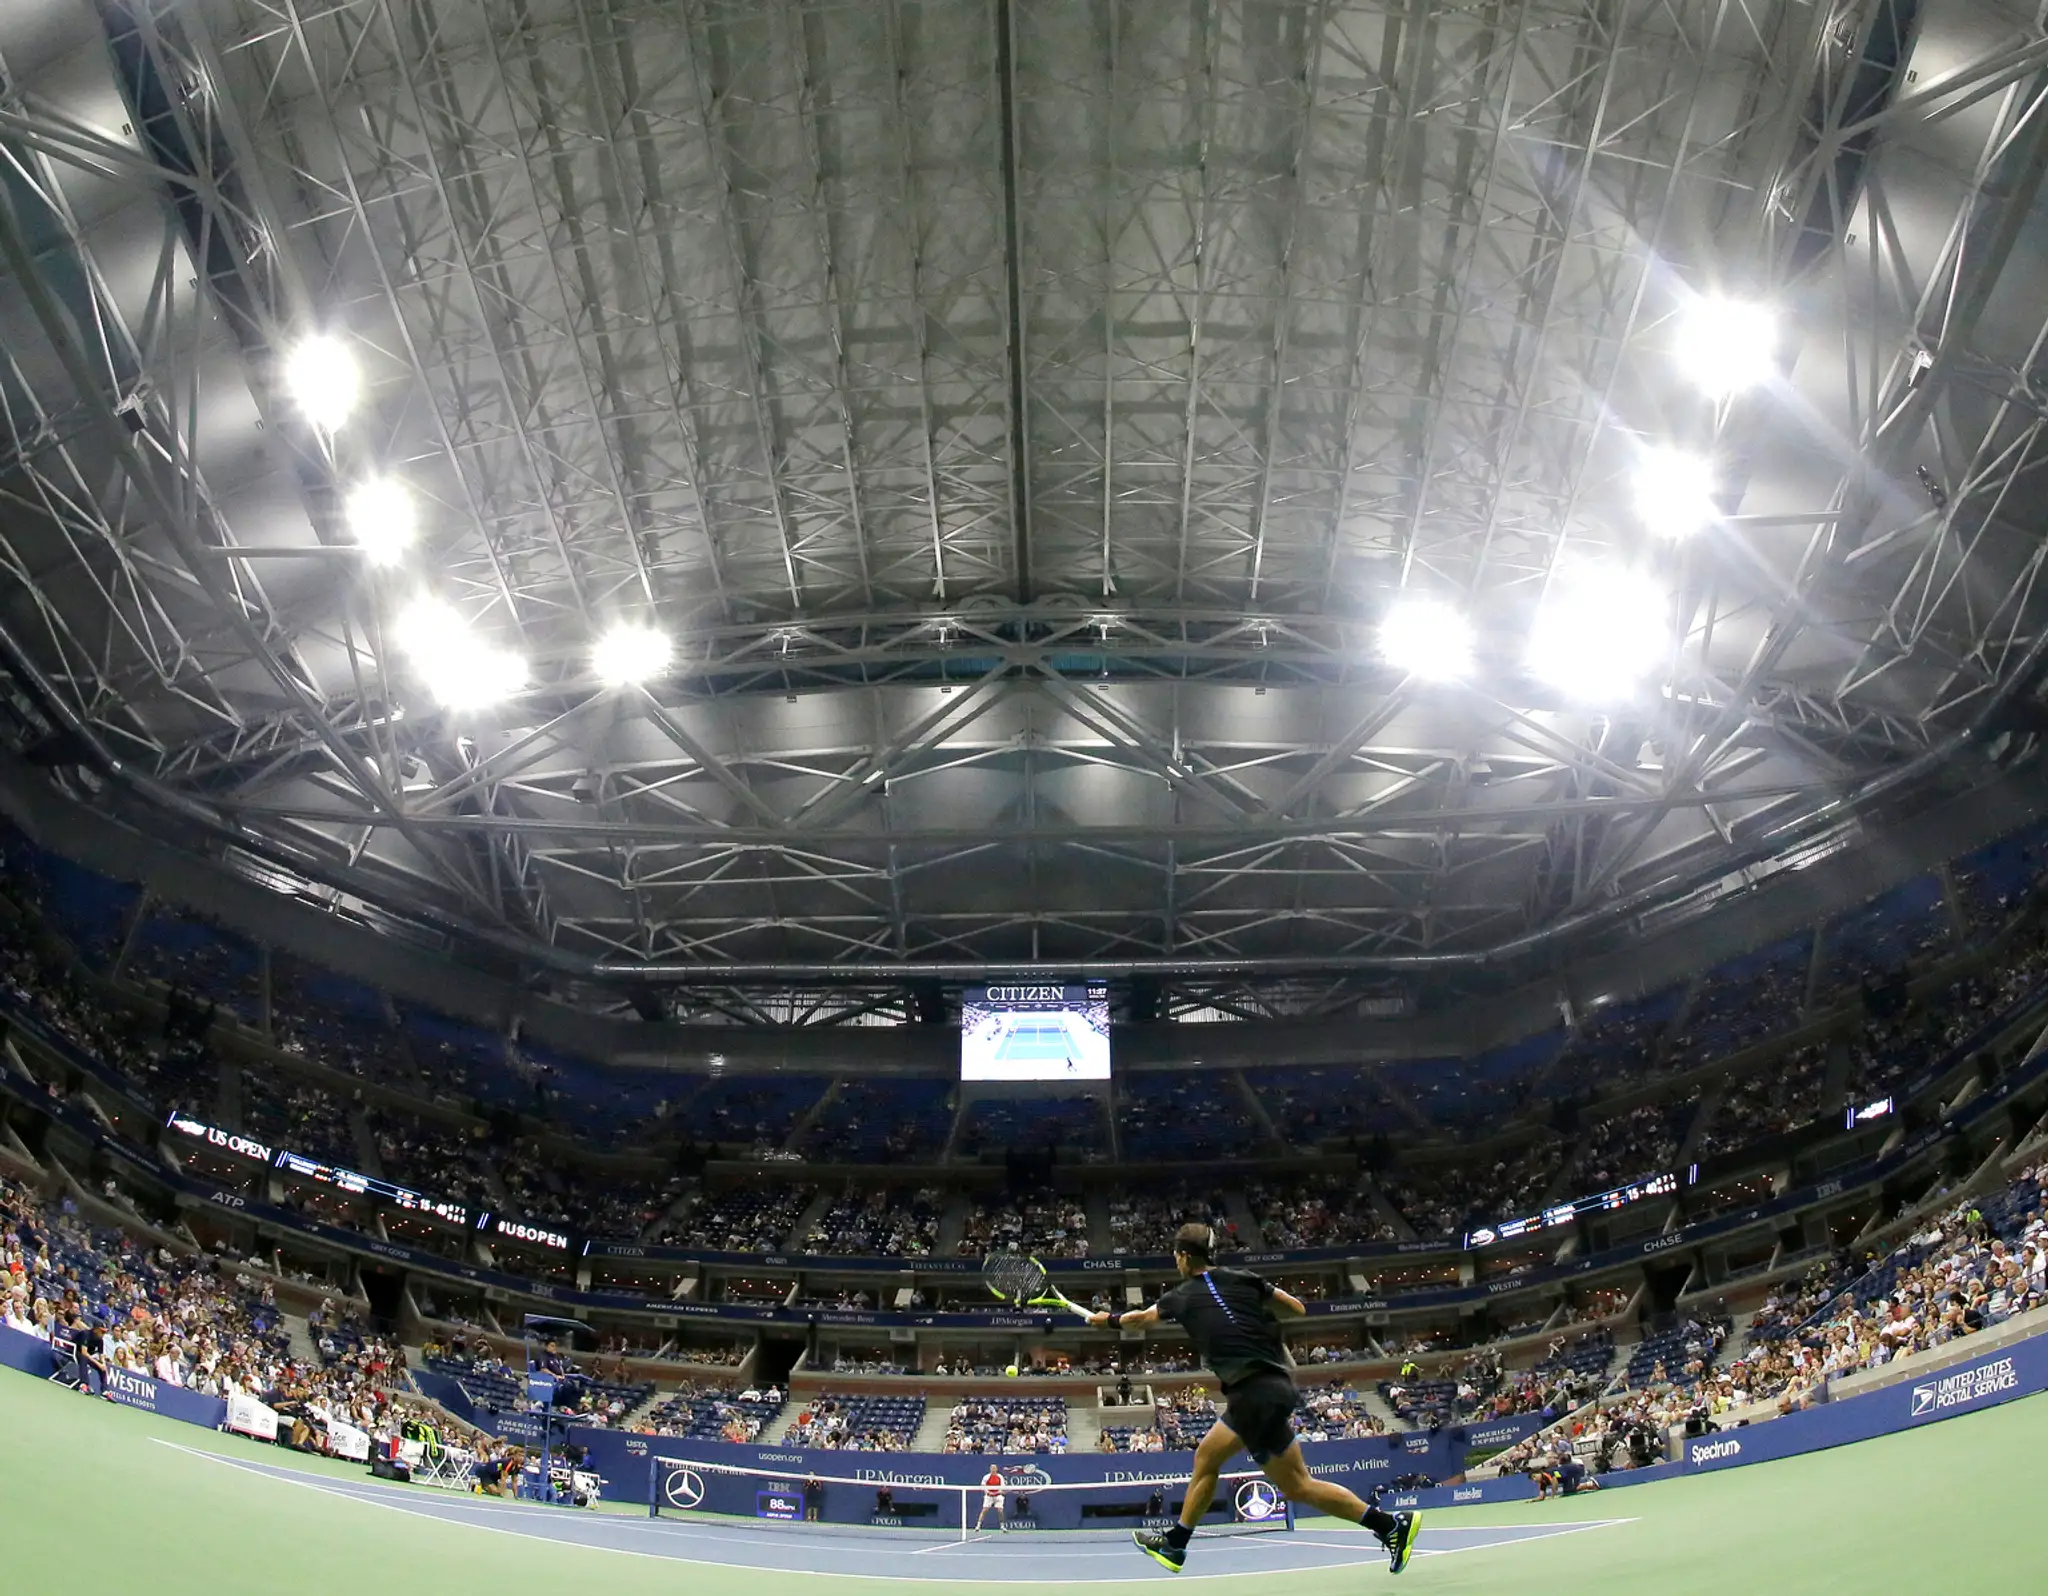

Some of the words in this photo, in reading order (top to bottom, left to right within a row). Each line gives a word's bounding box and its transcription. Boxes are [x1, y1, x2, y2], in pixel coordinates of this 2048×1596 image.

[987, 986, 1065, 1001] CITIZEN
[207, 1127, 229, 1146] US
[228, 1135, 272, 1162] OPEN
[1627, 1187, 1640, 1201] 15
[1816, 1180, 1843, 1197] IBM
[211, 1191, 245, 1208] ATP
[497, 1220, 569, 1249] #USOPEN
[1643, 1233, 1682, 1253] CHASE
[607, 1245, 645, 1257] CITIZEN
[1083, 1260, 1122, 1270] CHASE
[531, 1282, 555, 1298] IBM
[1488, 1279, 1522, 1294] WESTIN
[645, 1303, 684, 1312] AMERICAN
[685, 1306, 719, 1314] EXPRESS
[1329, 1303, 1362, 1313] Emirates
[1363, 1300, 1388, 1310] Airline
[1938, 1370, 1975, 1393] UNITED
[1975, 1357, 2012, 1382] STATES
[106, 1366, 156, 1400] WESTIN
[1936, 1387, 1973, 1409] POSTAL
[1974, 1371, 2016, 1398] SERVICE
[497, 1424, 538, 1438] EXPRESS
[498, 1418, 544, 1432] AMERICAN
[1471, 1426, 1520, 1440] AMERICAN
[1471, 1434, 1512, 1446] EXPRESS
[626, 1440, 648, 1448] USTA
[1406, 1438, 1429, 1448] USTA
[758, 1452, 803, 1463] usopen.org
[1692, 1440, 1735, 1467] Spectrum
[1309, 1462, 1350, 1476] mirates
[1352, 1457, 1390, 1471] Airline
[768, 1481, 790, 1493] IBM
[855, 1469, 945, 1491] JPMorgan
[1010, 1476, 1043, 1487] OPEN
[770, 1498, 784, 1510] 88
